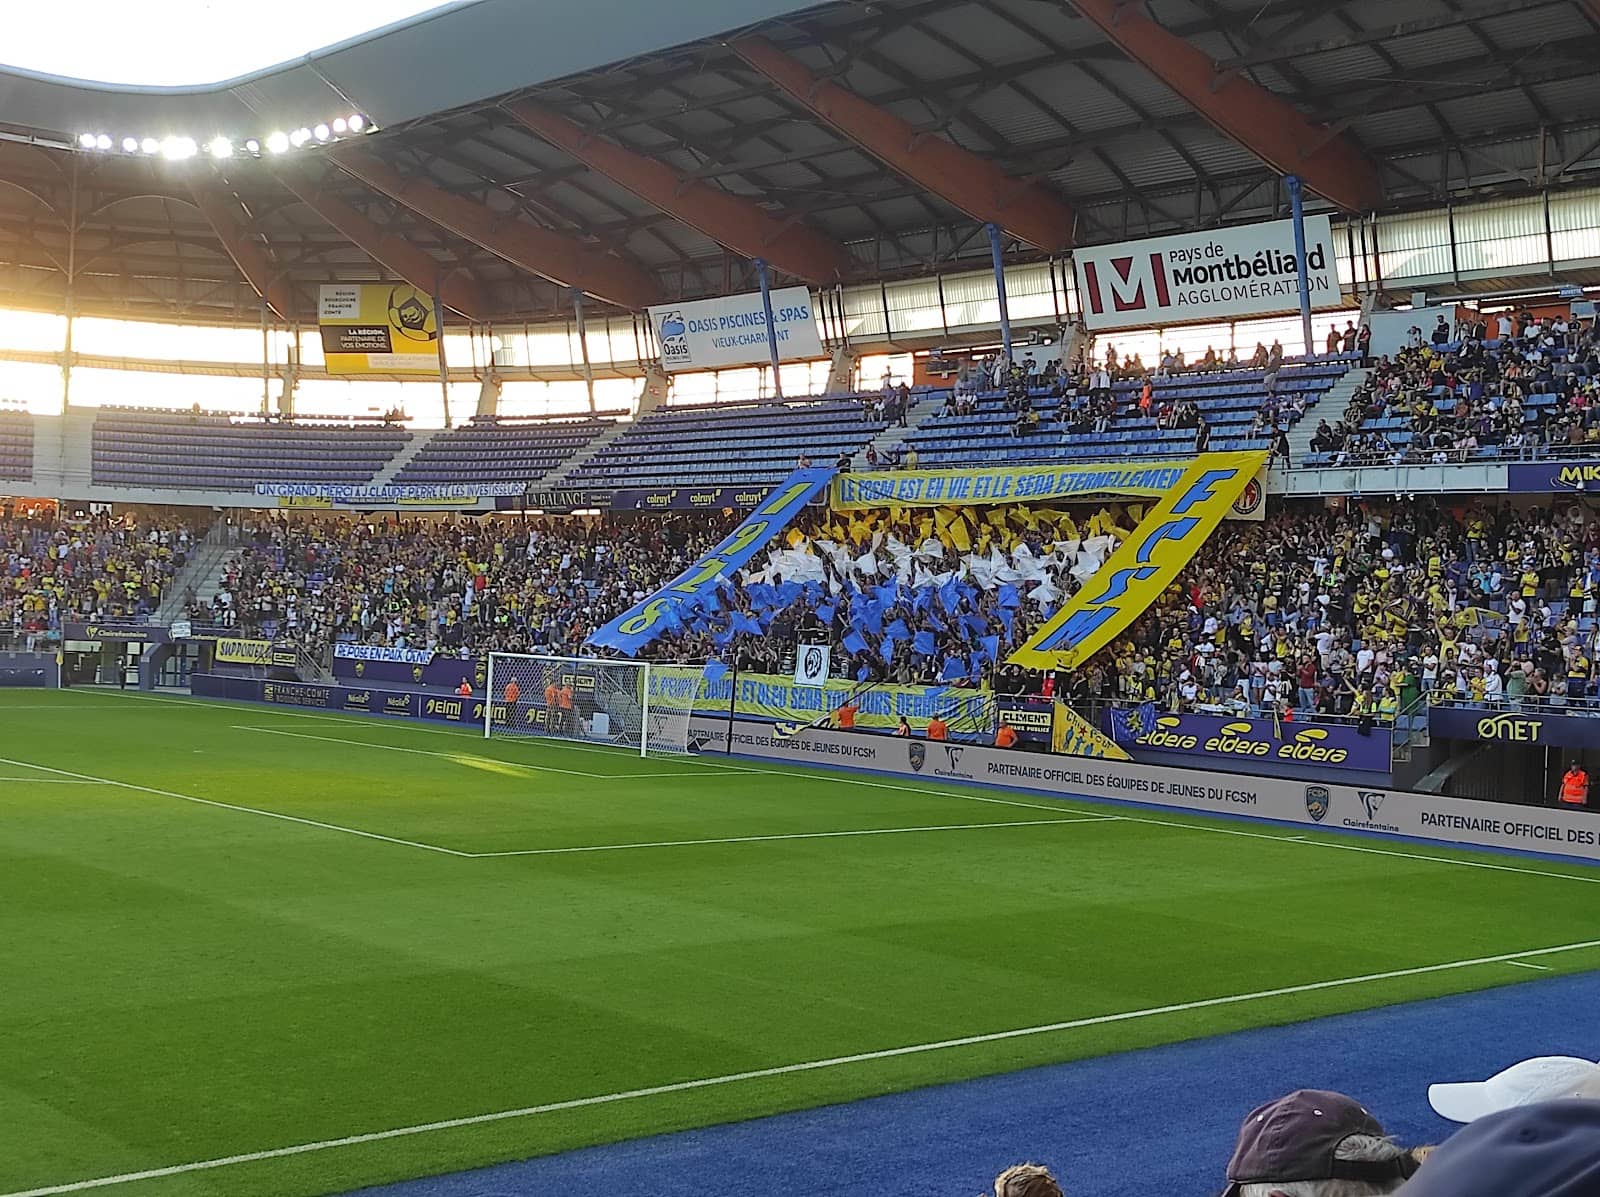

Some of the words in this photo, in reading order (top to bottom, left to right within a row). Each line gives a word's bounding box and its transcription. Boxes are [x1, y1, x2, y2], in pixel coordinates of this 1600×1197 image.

[1170, 246, 1202, 263] Pays
[1204, 241, 1224, 259] de
[1172, 243, 1326, 287] Montbéliad
[688, 317, 718, 334] OASIS
[719, 310, 767, 330] PISCINES
[780, 305, 809, 322] SPAS
[663, 343, 689, 356] Oasis
[711, 329, 790, 349] VIEUX-CHARMNT
[256, 485, 276, 496] UN
[277, 485, 318, 497] GRAND
[319, 486, 353, 497] MERCI
[408, 486, 438, 497] PIERRE
[439, 485, 449, 496] ET
[451, 485, 465, 496] LES
[466, 483, 526, 497] INVESTISSEURS
[841, 479, 855, 502] LE
[897, 478, 926, 500] EST
[925, 477, 946, 499] EN
[949, 476, 972, 499] VIE
[972, 476, 993, 498] ET
[992, 475, 1013, 498] LE
[1014, 474, 1055, 497] SERA
[1054, 468, 1187, 495] ETERNELLEMEN
[539, 492, 588, 506] BALANCE
[646, 493, 672, 506] colruyt
[689, 492, 716, 506] colruyt
[734, 491, 762, 505] colruyt
[337, 645, 368, 659] REPOSE
[369, 646, 381, 660] EN
[382, 647, 404, 661] PAIX
[742, 680, 757, 703] ET
[790, 686, 822, 712] SERA
[825, 688, 892, 716] TOUOURS
[686, 729, 725, 742] ARTENAIRE
[755, 736, 770, 748] DES
[800, 740, 811, 752] DE
[812, 742, 840, 755] JEUNES
[841, 744, 852, 756] DU
[853, 746, 876, 759] FCSM
[1204, 735, 1271, 756] eldera
[1278, 742, 1348, 763] eldera
[987, 762, 1042, 781] PARTENAIRE
[1043, 768, 1084, 785] OFFICIEL
[1086, 773, 1105, 787] DES
[1106, 774, 1149, 792] ÉQUIPES
[1150, 781, 1165, 794] DE
[1166, 783, 1205, 799] JEUNES
[1207, 787, 1223, 801] DU
[1225, 789, 1257, 805] FCSM
[1342, 818, 1400, 833] Clairefontaine
[1421, 812, 1501, 834] PARTENAIRE
[1503, 822, 1564, 842] OFFICIEL
[1567, 828, 1594, 845] DES
